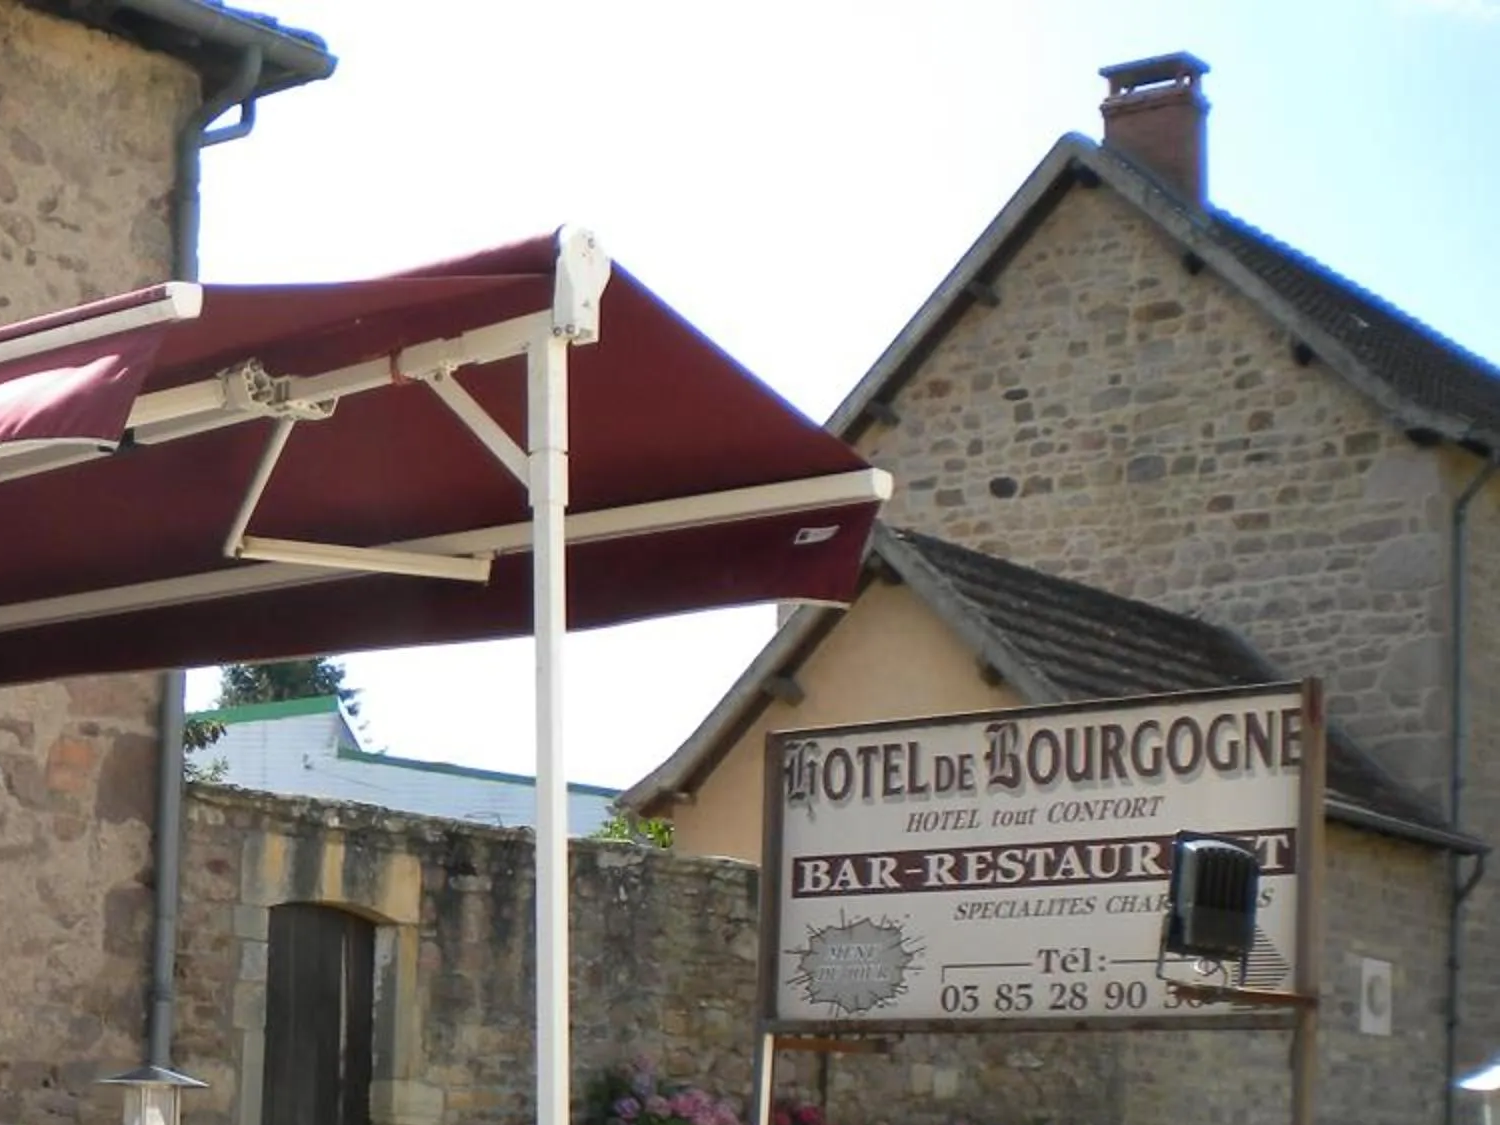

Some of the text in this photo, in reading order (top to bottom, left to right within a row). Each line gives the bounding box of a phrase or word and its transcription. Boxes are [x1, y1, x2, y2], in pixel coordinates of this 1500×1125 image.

[934, 753, 975, 793] DE
[984, 706, 1300, 789] BOURGOGNE
[905, 795, 1165, 833] HOTEL tout CONFORT
[799, 834, 1290, 894] BAR-RESTAURT
[953, 896, 1098, 921] SPECIALITES
[940, 984, 980, 1013] 03
[994, 983, 1033, 1012] 85
[1048, 982, 1089, 1011] 28
[1104, 980, 1148, 1010] 90
